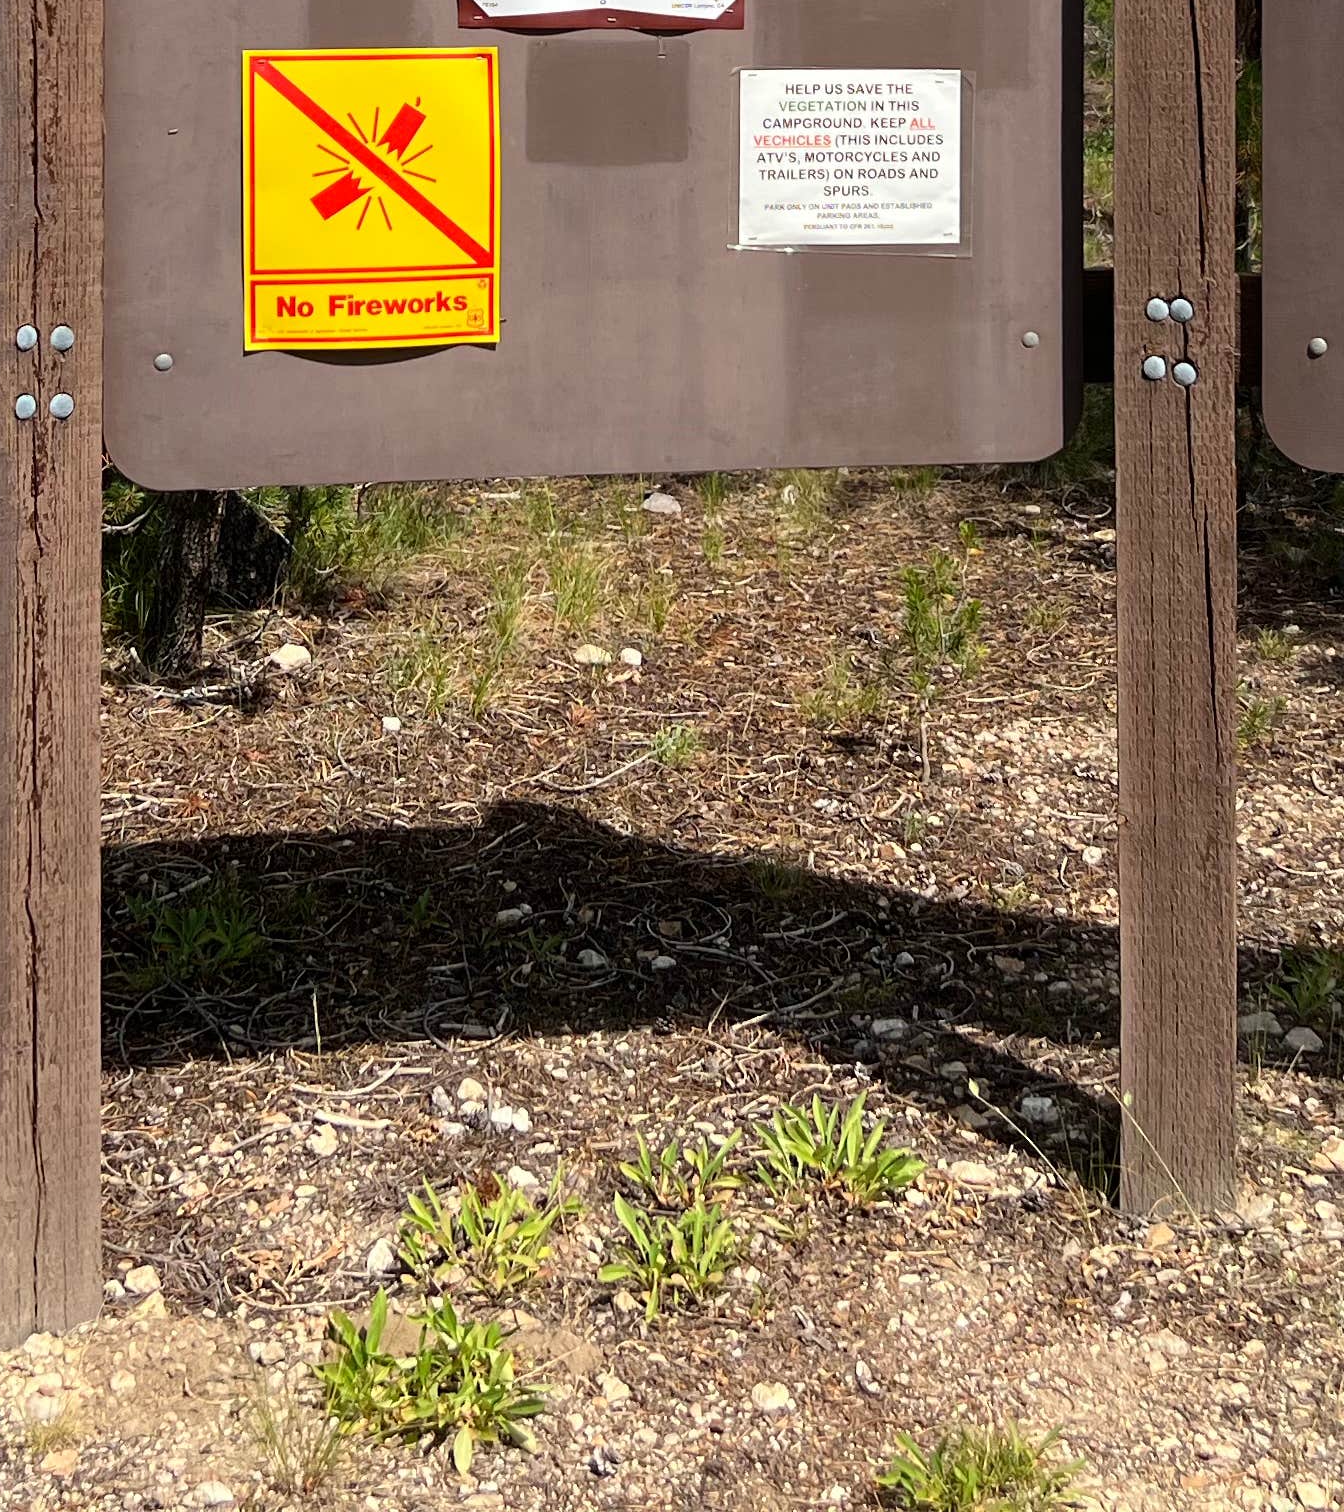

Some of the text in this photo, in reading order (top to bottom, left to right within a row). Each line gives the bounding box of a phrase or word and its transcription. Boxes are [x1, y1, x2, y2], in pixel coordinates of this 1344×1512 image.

[785, 84, 913, 95] HELP US SAVE THE
[779, 101, 920, 112] VEGETATION IN THIS
[870, 118, 906, 129] KEEP
[910, 118, 935, 130] ALL
[754, 135, 944, 148] VECHICLES (THIS INCLUDES
[756, 152, 940, 164] ATV'S, MOTORCYCLES AND
[759, 169, 939, 181] TRAILERS) ON ROADS AND
[823, 186, 872, 197] SPURS.
[276, 291, 468, 318] No Fireworks
